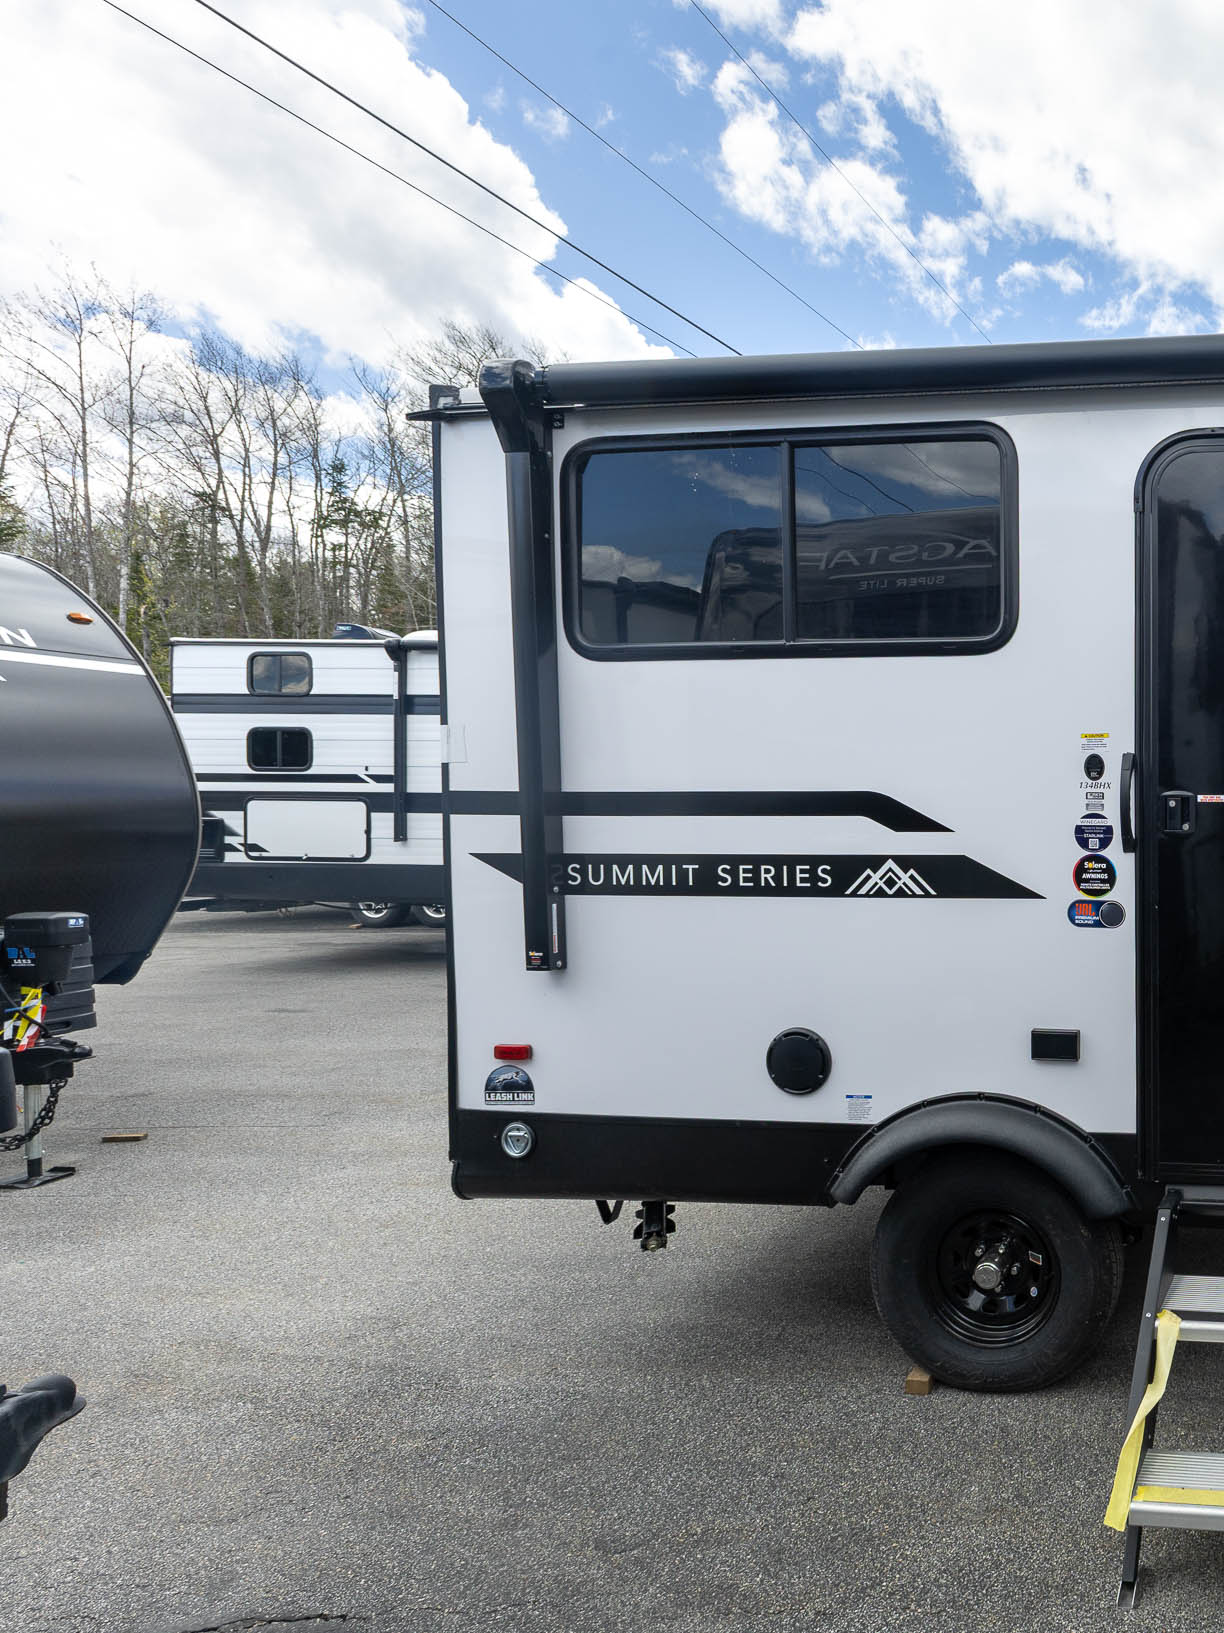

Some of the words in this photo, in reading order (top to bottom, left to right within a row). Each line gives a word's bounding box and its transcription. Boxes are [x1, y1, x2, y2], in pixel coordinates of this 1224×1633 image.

[1079, 781, 1112, 790] 134BHX
[1083, 860, 1107, 869] Solera
[567, 863, 700, 886] SUMMIT
[717, 864, 833, 887] SERIES
[1075, 903, 1096, 917] JBL
[485, 1092, 513, 1101] LEASH
[514, 1092, 534, 1101] LINK
